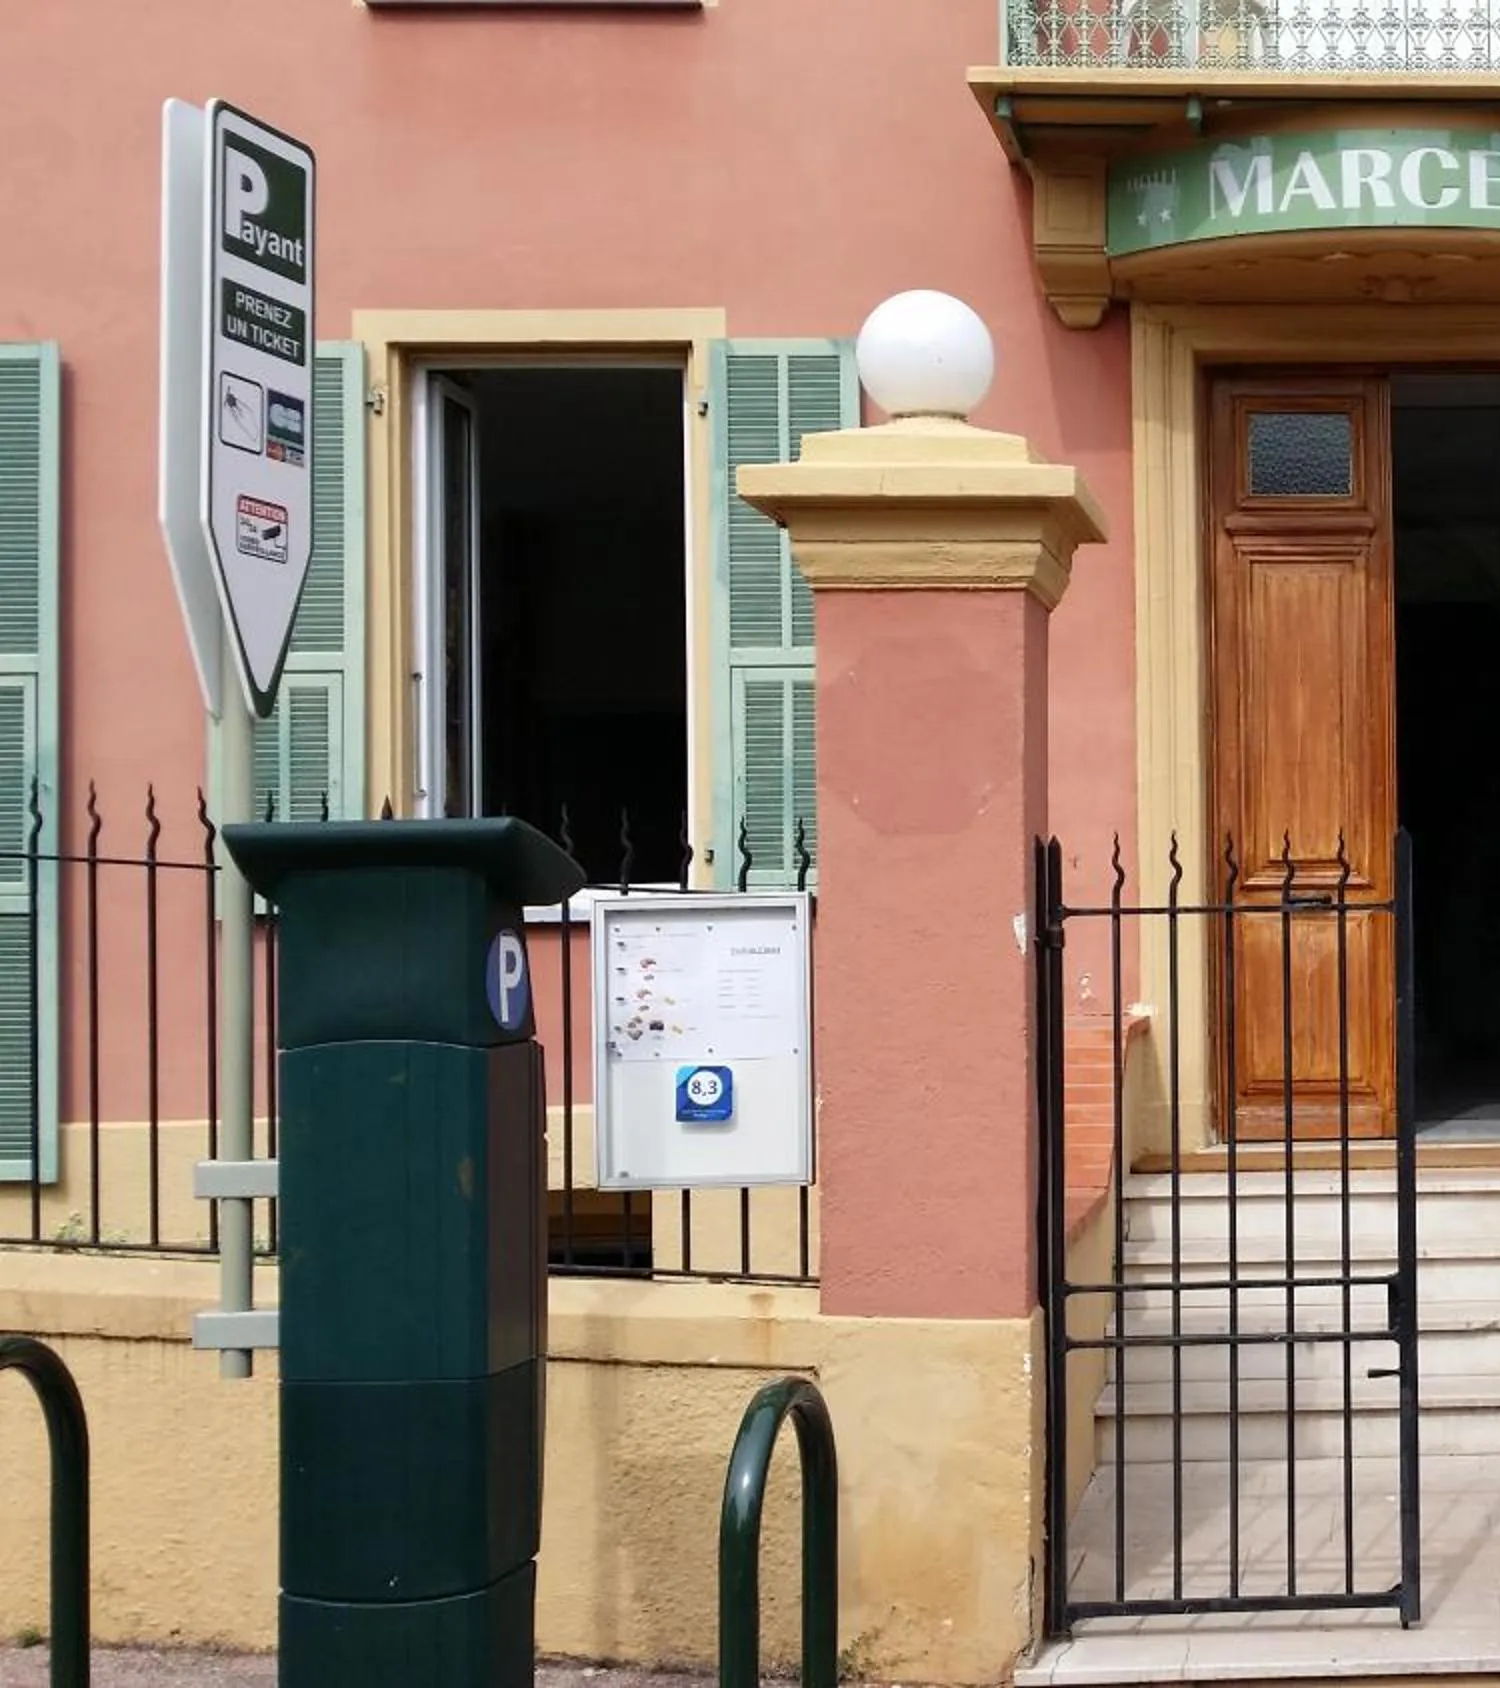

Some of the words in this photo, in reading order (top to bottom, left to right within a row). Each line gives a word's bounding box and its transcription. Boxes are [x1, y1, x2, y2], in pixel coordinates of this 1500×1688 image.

[225, 145, 304, 267] Payant
[236, 290, 293, 329] PRENEZ
[227, 314, 248, 340] UN
[250, 322, 300, 358] TICKET
[499, 935, 523, 1022] P
[690, 1079, 718, 1096] 8,3
